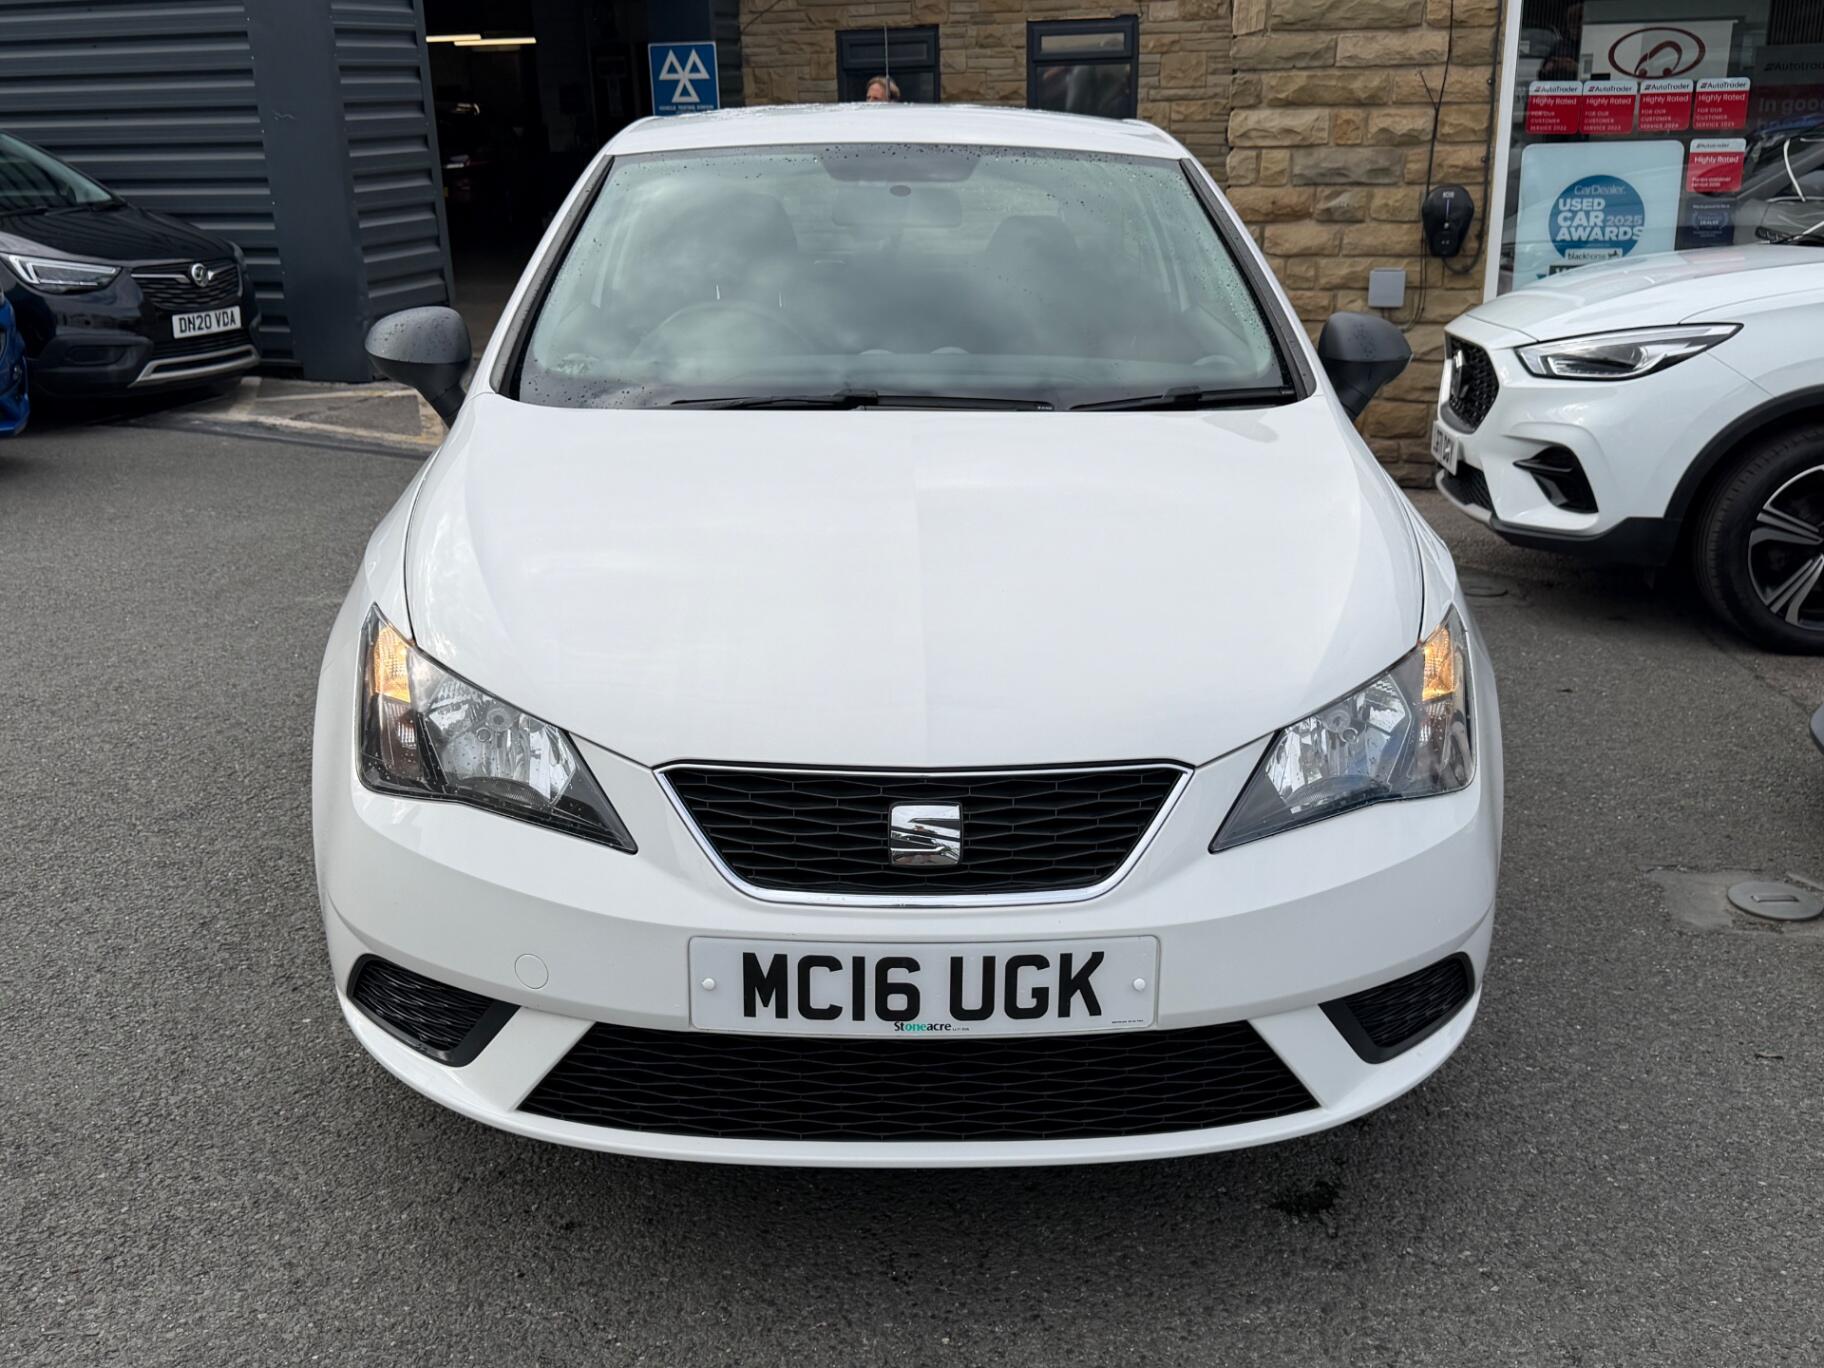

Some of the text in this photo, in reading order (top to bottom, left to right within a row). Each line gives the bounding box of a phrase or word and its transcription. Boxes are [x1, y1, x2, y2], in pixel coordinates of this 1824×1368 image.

[1540, 85, 1578, 93] AutoTrader
[1706, 81, 1746, 89] AutoTrader
[1532, 96, 1577, 106] Highly Rated
[1586, 96, 1631, 106] Highly Rated
[1642, 94, 1689, 104] Highly Rated
[1698, 93, 1745, 103] Highly Rated
[1694, 156, 1717, 164] Highly
[1558, 198, 1606, 211] USED
[1557, 211, 1643, 227] CAR 2025
[1555, 226, 1645, 241] AWARDS
[179, 310, 237, 334] DN20 VDA
[742, 950, 1105, 1022] MC16 UGK
[893, 1021, 952, 1032] Stoneacre
